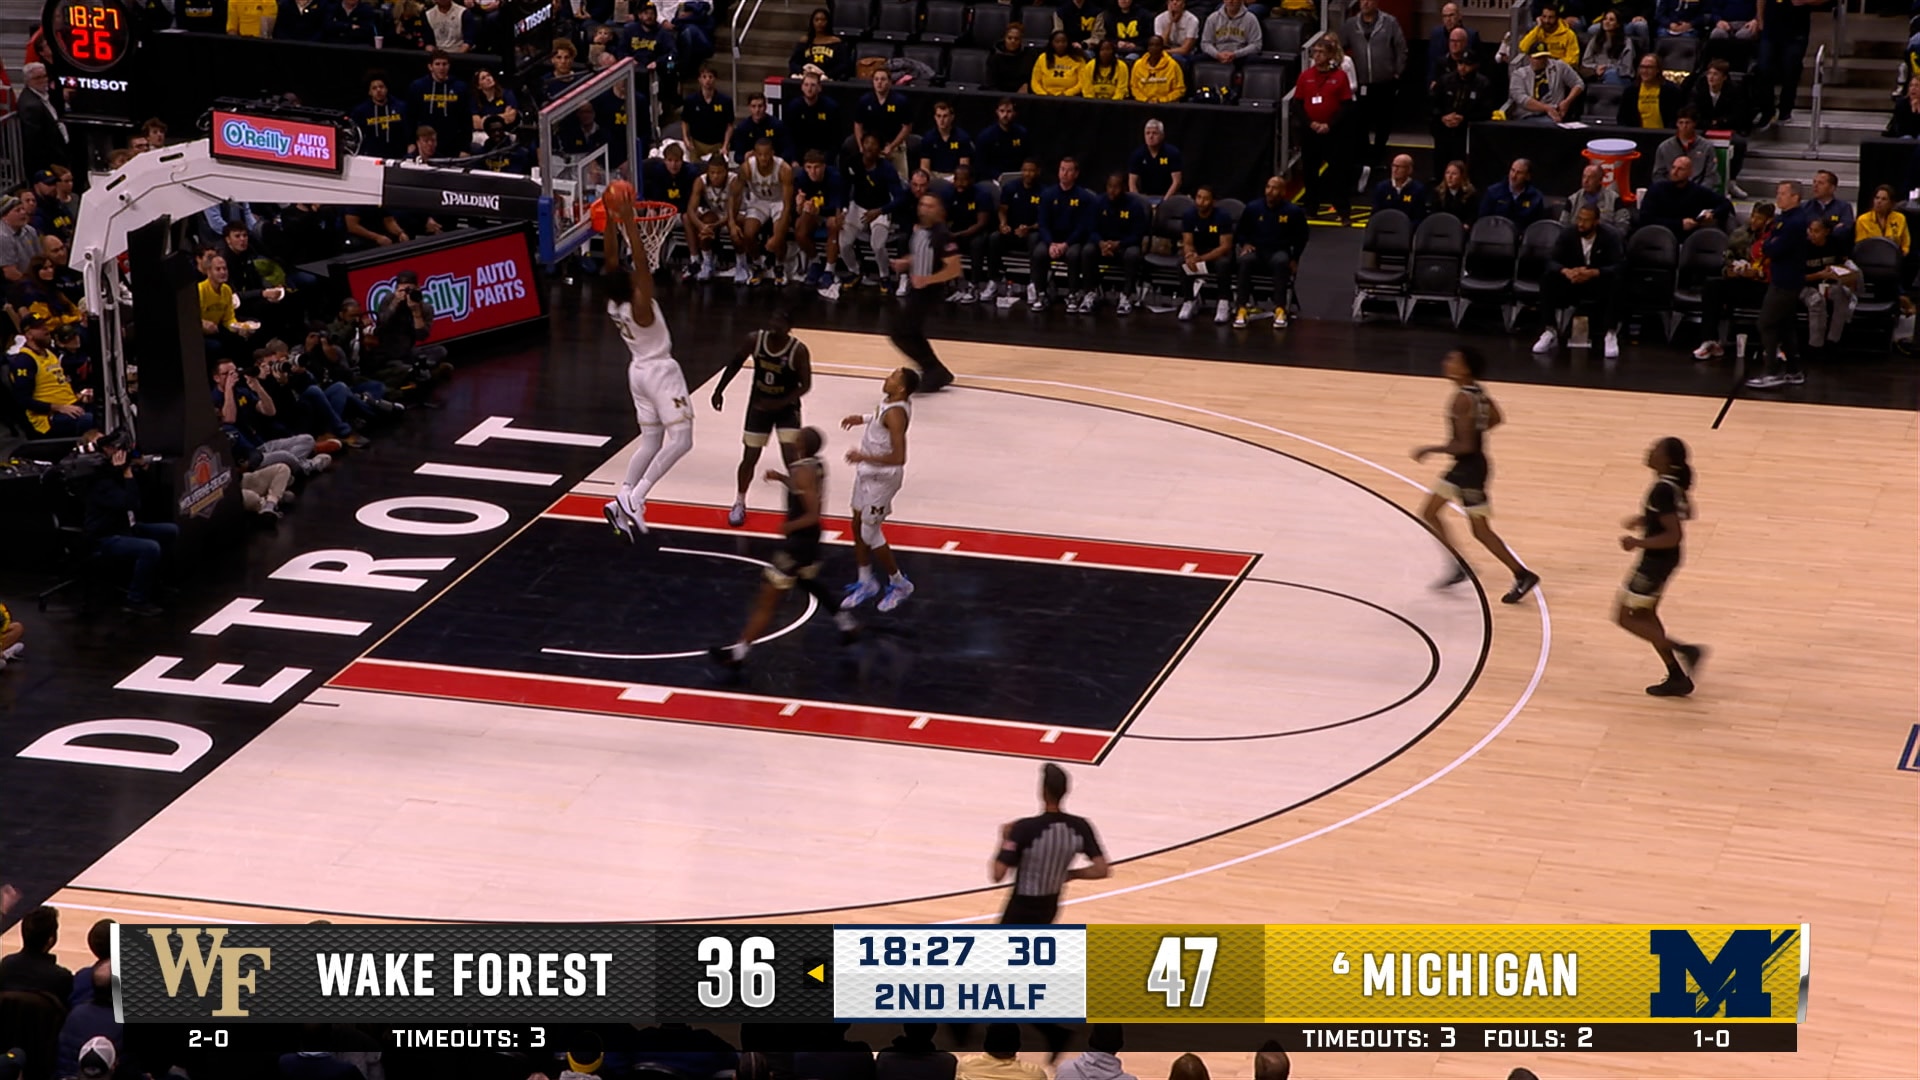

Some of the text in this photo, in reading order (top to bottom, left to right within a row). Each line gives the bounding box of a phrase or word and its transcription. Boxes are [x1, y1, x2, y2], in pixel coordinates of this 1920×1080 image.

[69, 5, 119, 30] 18:27
[1117, 20, 1138, 38] M
[72, 29, 112, 59] 26
[77, 78, 128, 91] TISSOT
[222, 120, 291, 156] O'Reilly
[297, 132, 327, 148] AUTO
[293, 143, 330, 160] PARTS
[441, 190, 500, 211] SPALDING
[476, 260, 517, 287] AUTO
[473, 279, 526, 308] PARTS
[765, 371, 775, 385] 0
[870, 505, 886, 516] M
[16, 416, 612, 773] DETROIT
